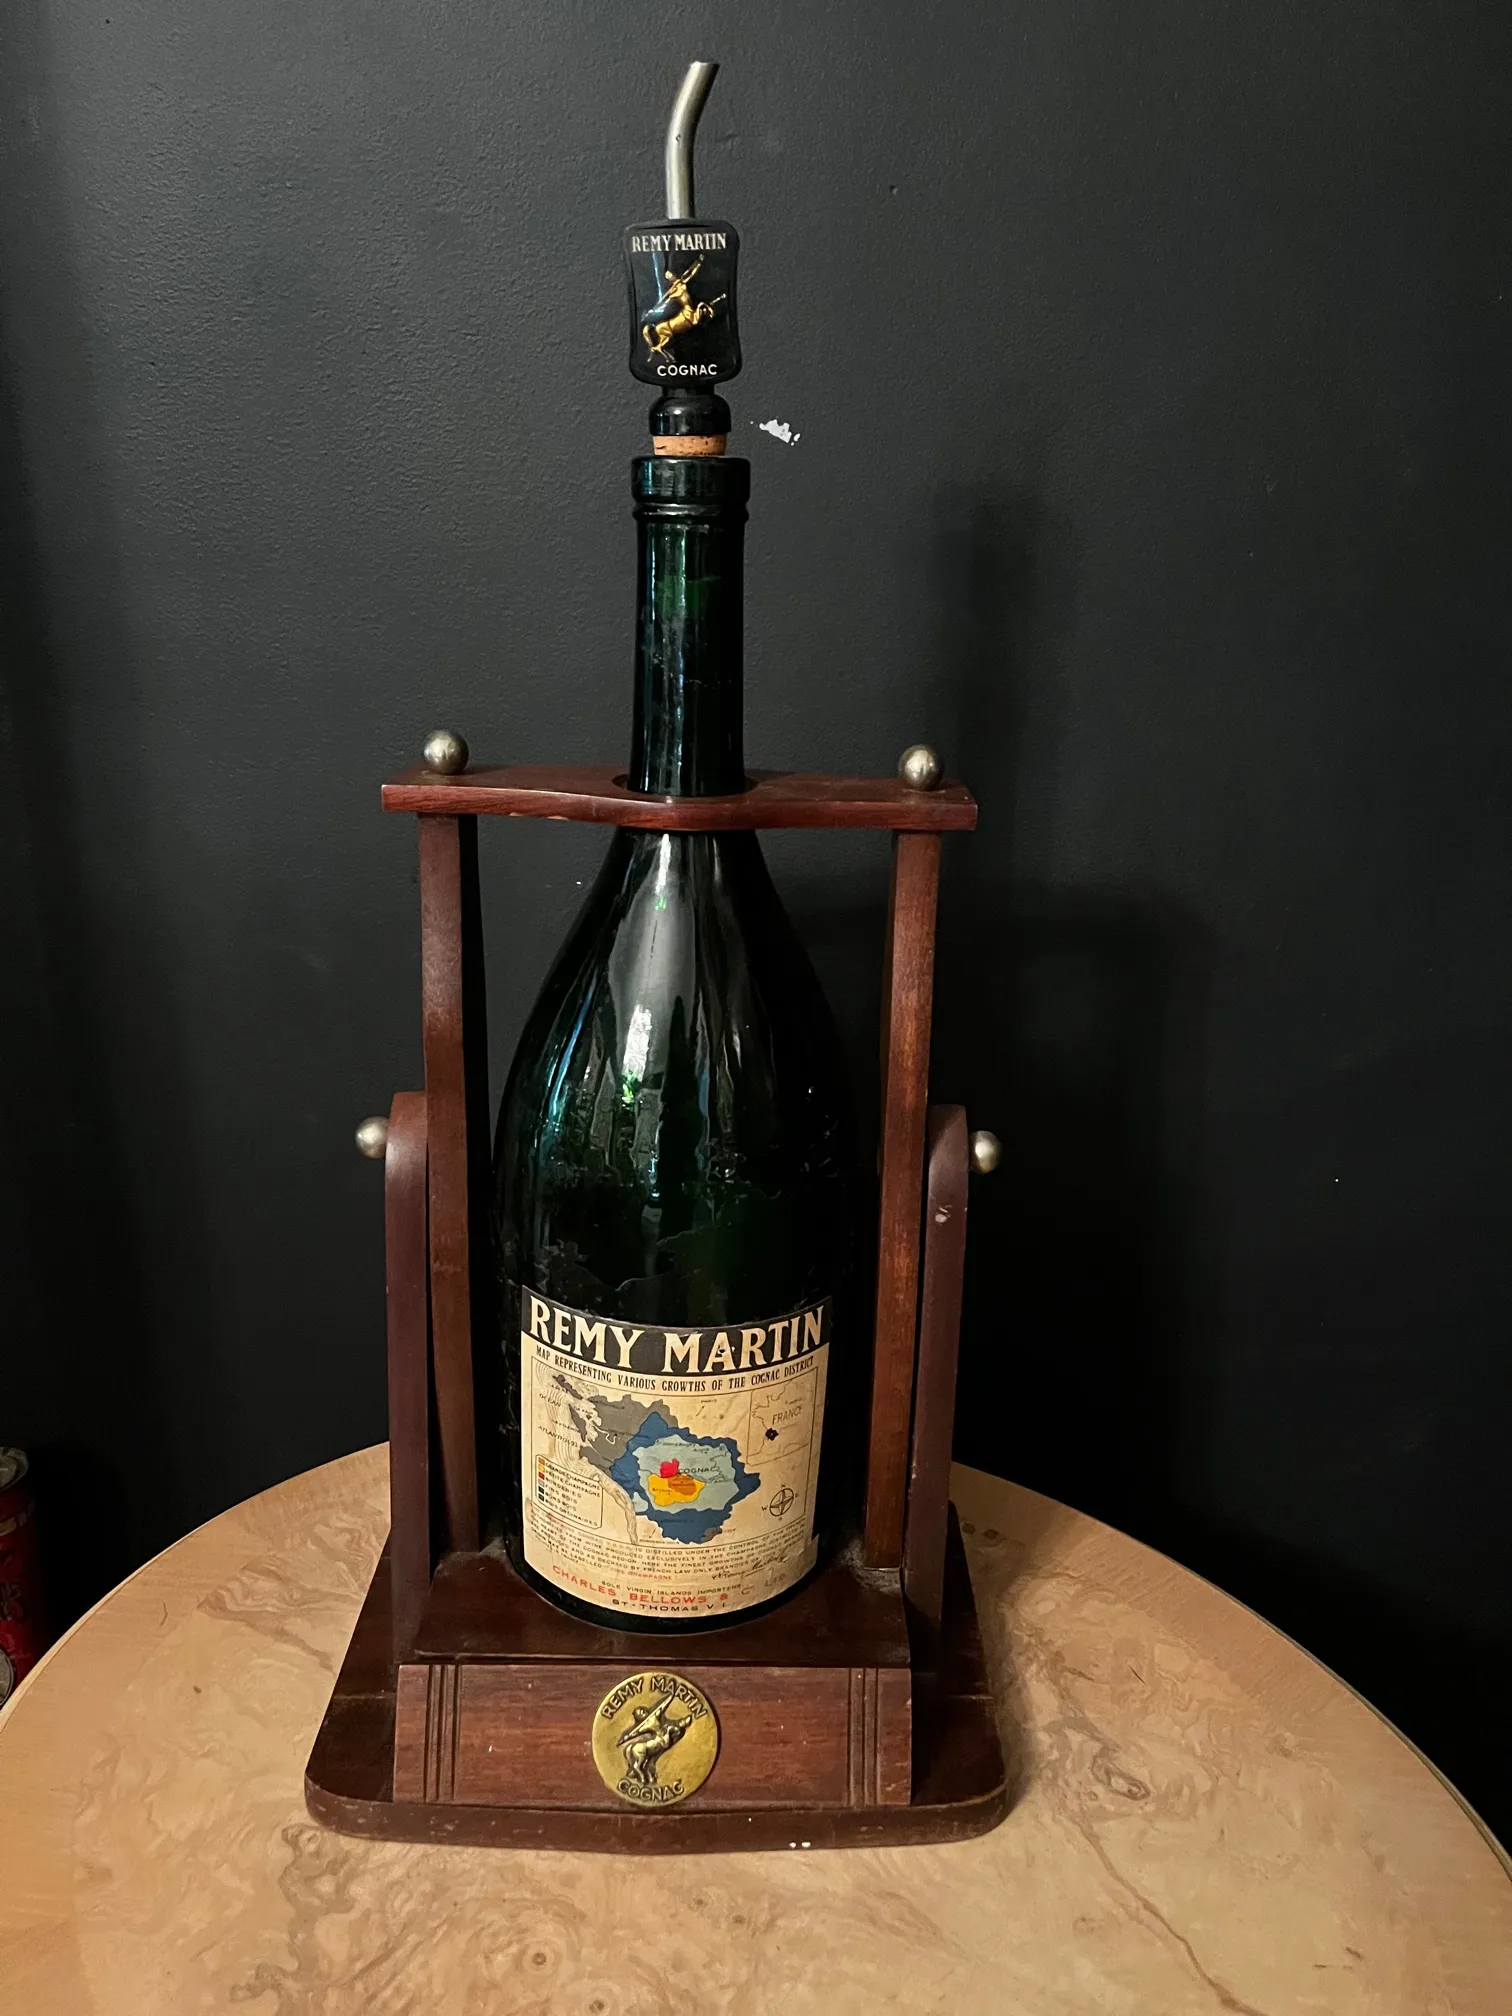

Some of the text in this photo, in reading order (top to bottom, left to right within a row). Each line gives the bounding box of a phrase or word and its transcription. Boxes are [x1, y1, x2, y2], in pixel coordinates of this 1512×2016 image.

[632, 233, 727, 252] REMY MARTIN
[657, 364, 718, 377] COGNAC
[529, 1295, 824, 1373] REMY MARTIN
[536, 1345, 814, 1392] MAP REPRESENTING VARIOUS GROWTHS OF THE COGNAC DISTRICT
[772, 1404, 802, 1425] FRANCE
[678, 1466, 716, 1474] COGNAC
[552, 1565, 616, 1596] CHARLES
[629, 1592, 707, 1604] BELLOWS
[626, 1586, 652, 1594] VIRGIN
[697, 1583, 741, 1595] IMPORTERS
[602, 1677, 707, 1719] REMY MARTIN
[618, 1780, 684, 1801] COGNAC
